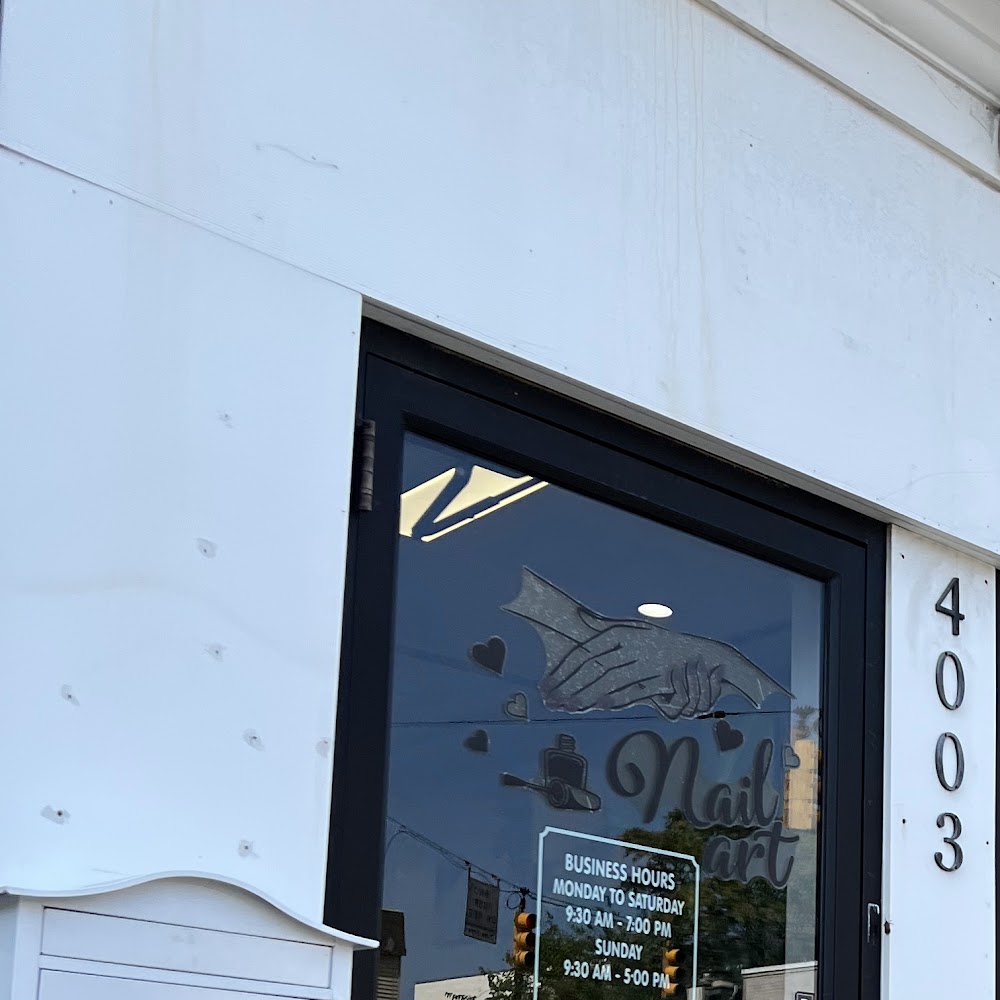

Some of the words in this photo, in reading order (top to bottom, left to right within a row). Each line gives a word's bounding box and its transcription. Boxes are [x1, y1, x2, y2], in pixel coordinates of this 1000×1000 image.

[934, 577, 965, 872] 4003
[565, 853, 628, 882] BUSINESS
[631, 866, 676, 891] HOURS
[553, 878, 606, 903] MONDAY
[609, 888, 625, 906] TO
[628, 891, 685, 916] SATURDAY
[565, 906, 592, 925] 9:30
[594, 911, 614, 929] AM
[626, 915, 651, 935] 7:00
[654, 921, 672, 938] PM
[595, 938, 643, 961] SUNDAY
[563, 959, 590, 978] 9:30
[592, 963, 612, 982] AM
[624, 968, 649, 987] 5:00
[653, 972, 670, 989] PM
